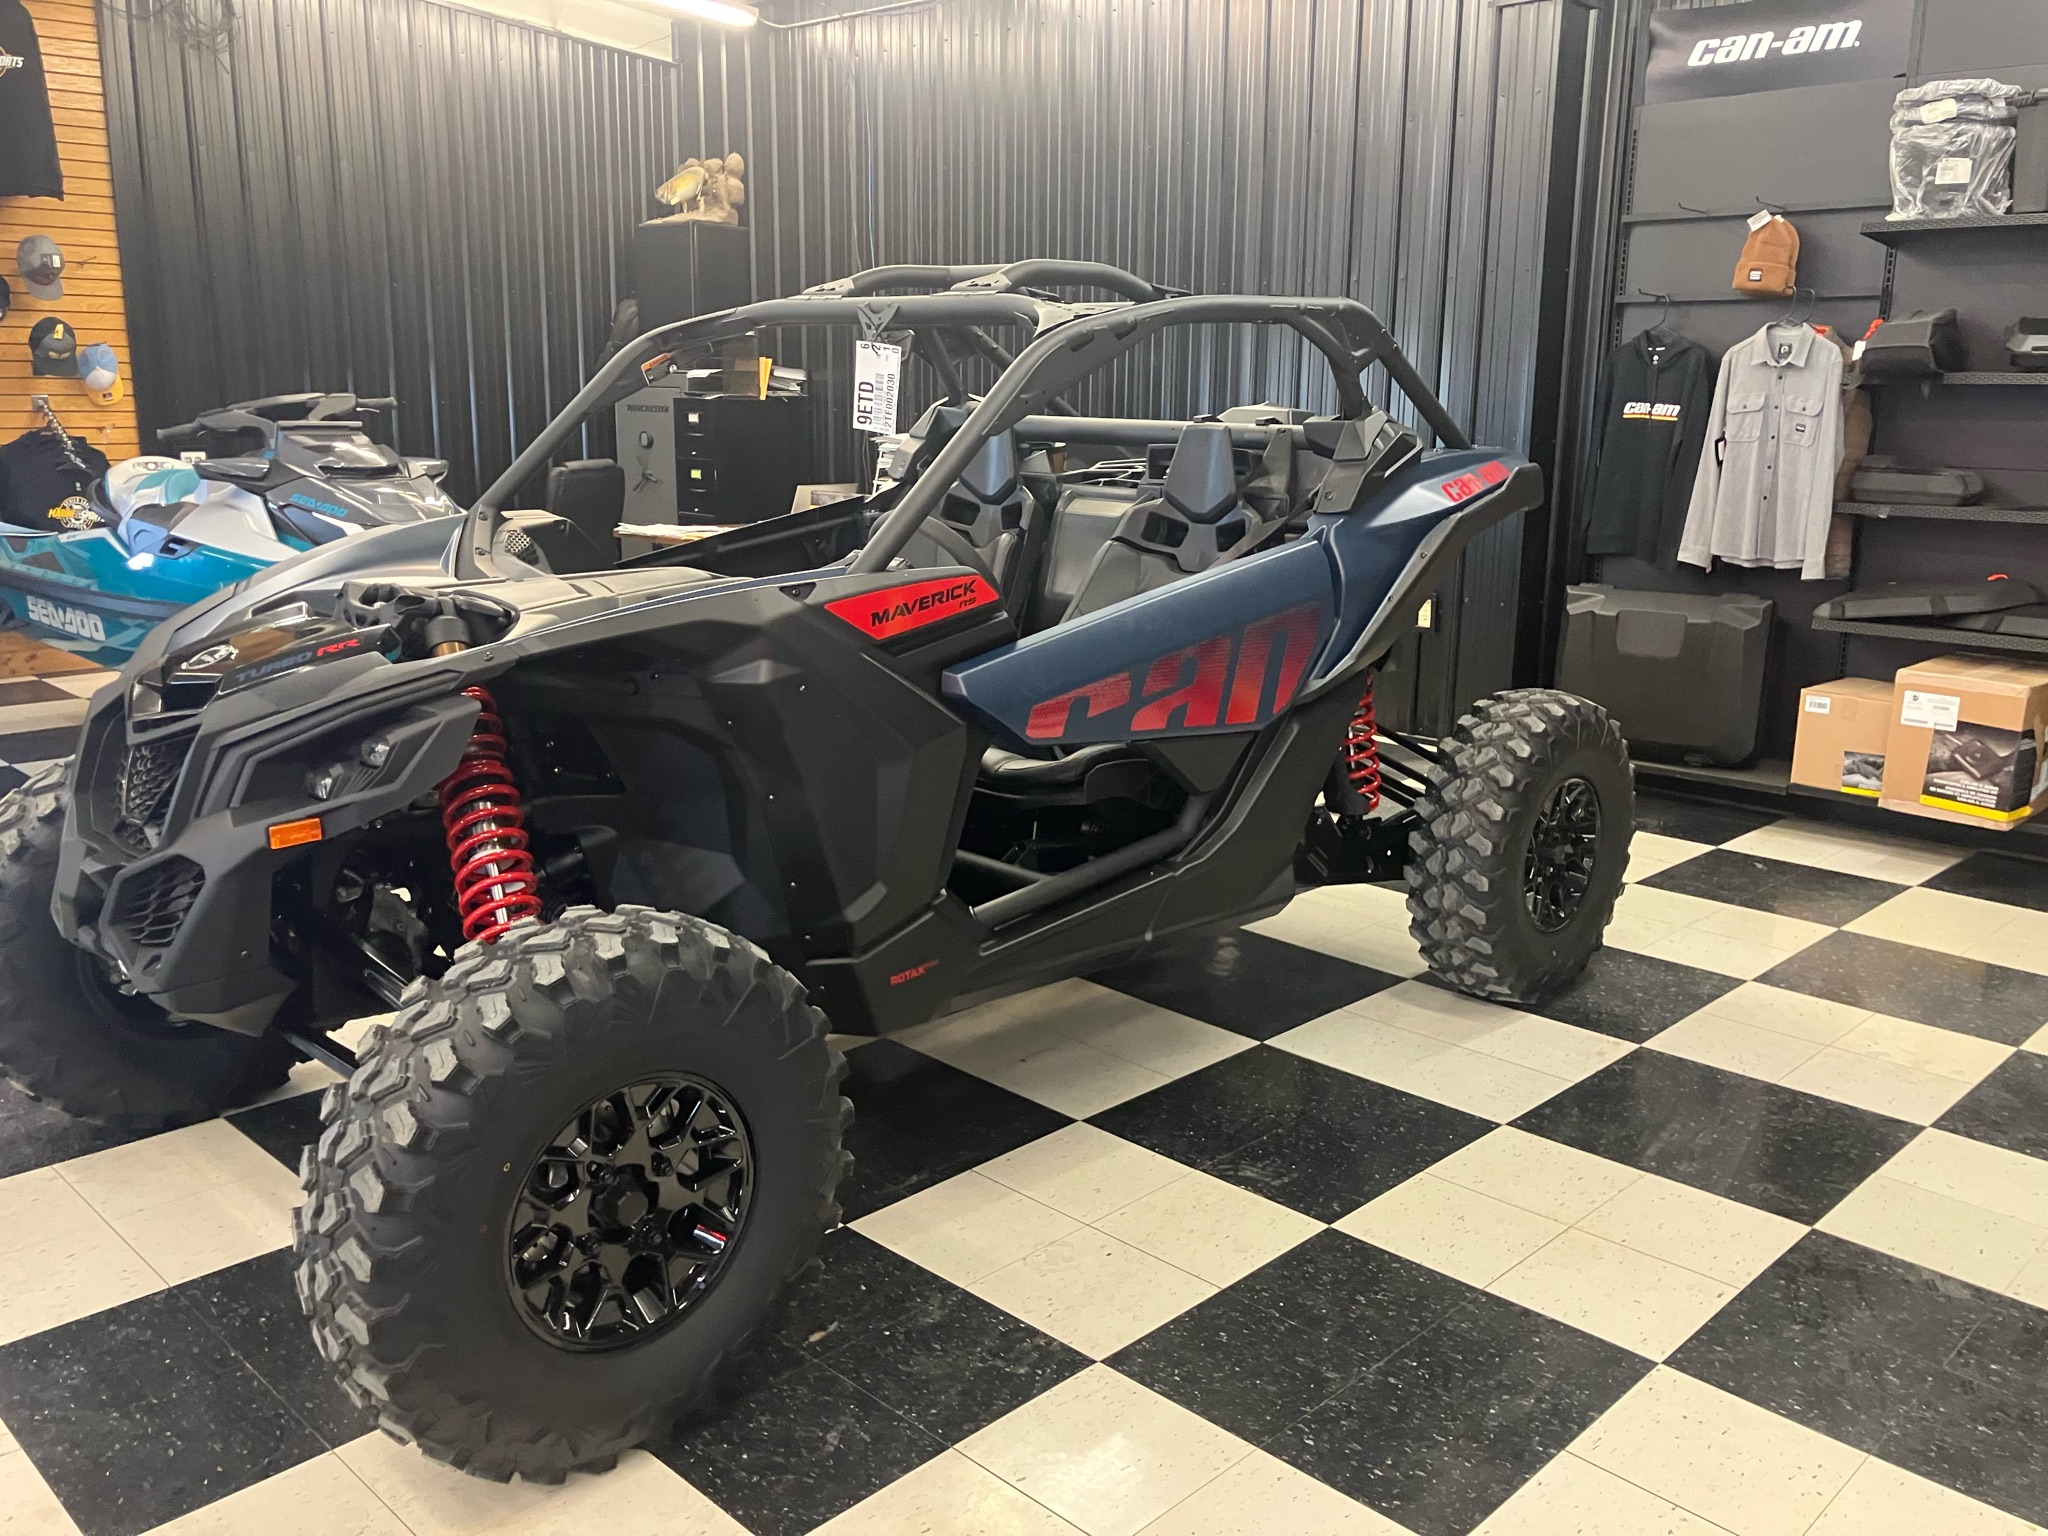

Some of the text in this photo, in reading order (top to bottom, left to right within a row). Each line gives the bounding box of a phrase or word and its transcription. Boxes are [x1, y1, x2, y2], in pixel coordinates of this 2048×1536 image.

[856, 381, 874, 425] 9ETD
[884, 373, 896, 428] 2TE002030
[870, 579, 977, 628] MAVERICK
[958, 597, 977, 609] RS
[236, 651, 313, 682] TURBO
[316, 638, 360, 656] RR
[889, 966, 926, 986] ROTAX
